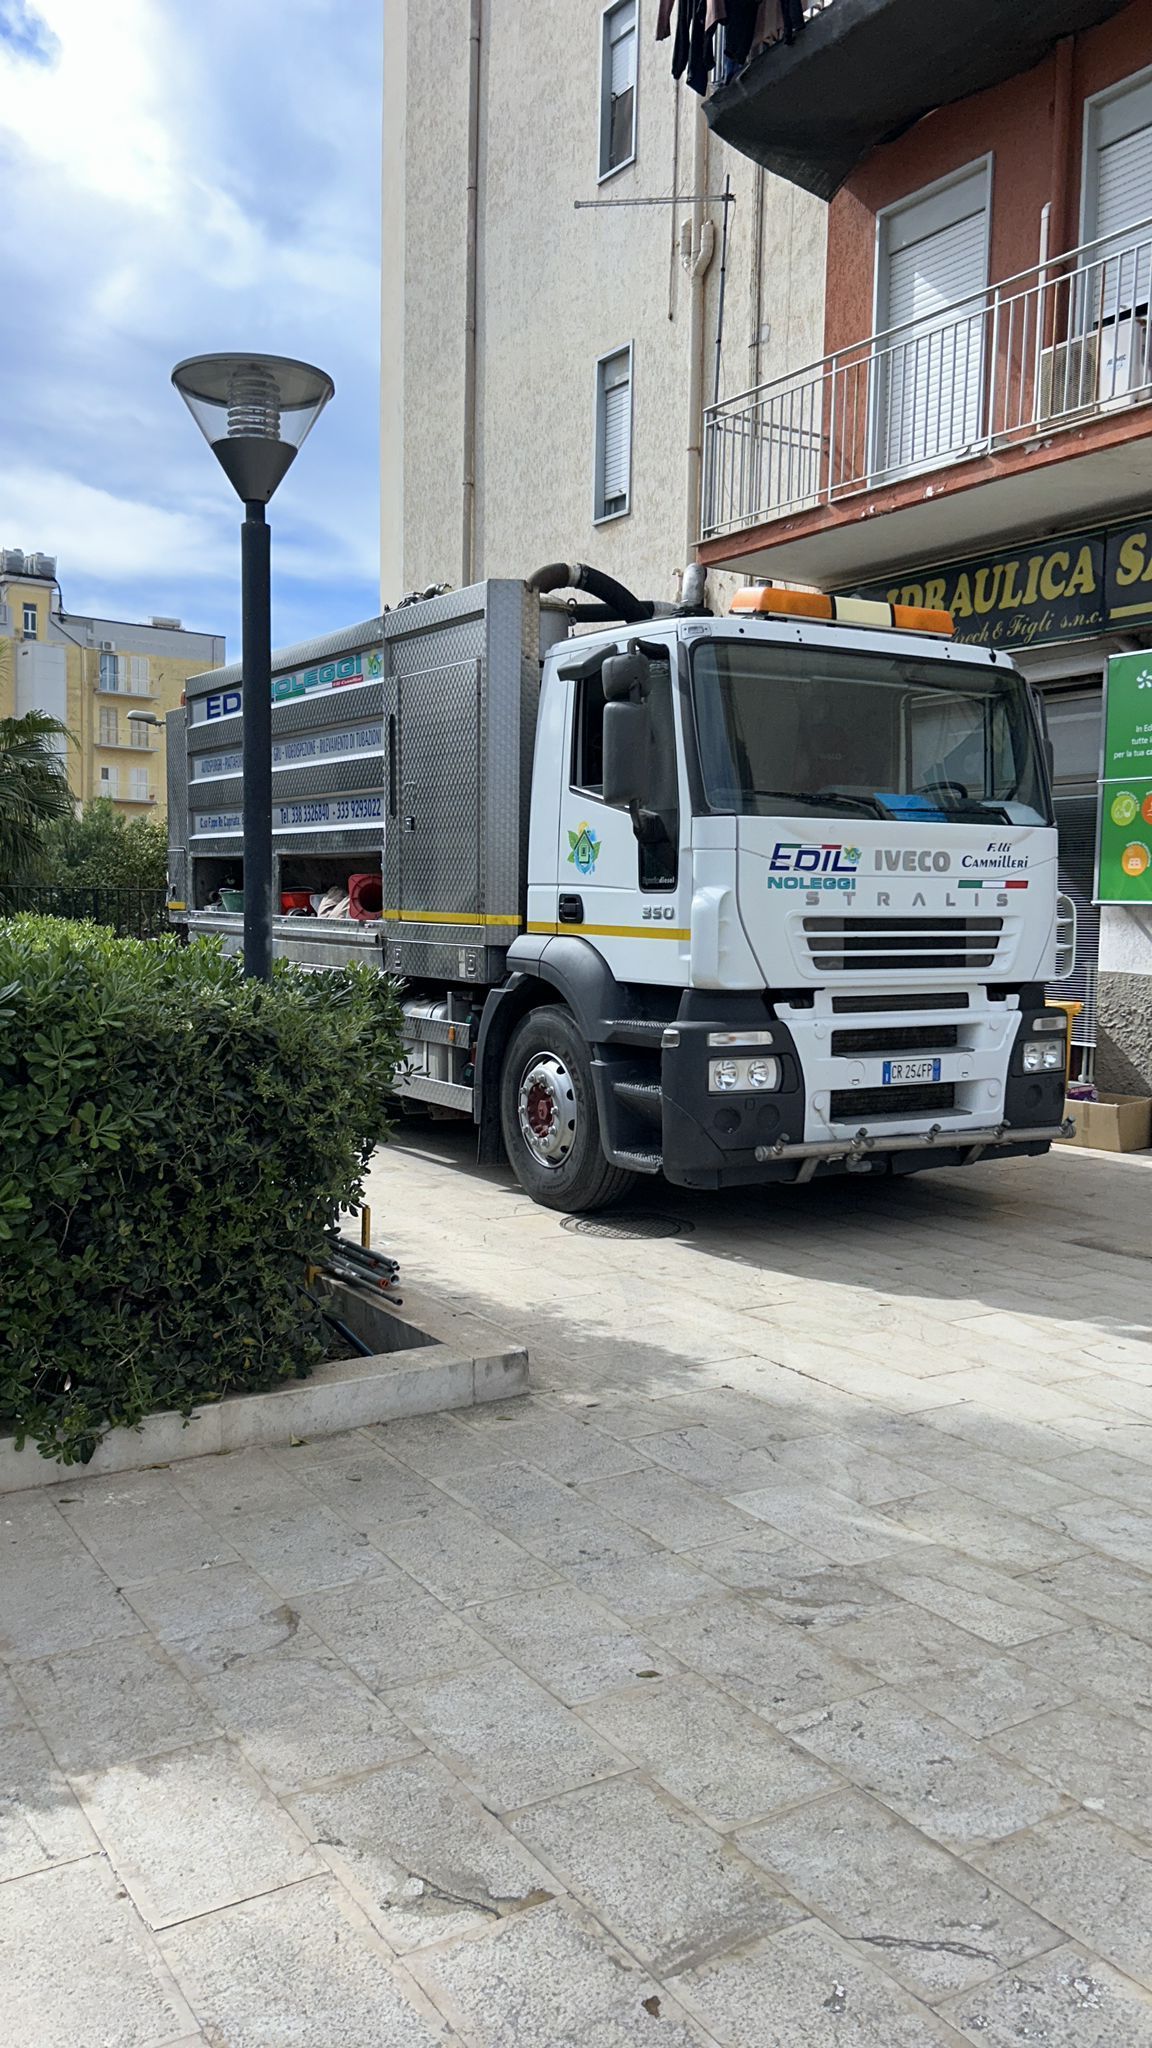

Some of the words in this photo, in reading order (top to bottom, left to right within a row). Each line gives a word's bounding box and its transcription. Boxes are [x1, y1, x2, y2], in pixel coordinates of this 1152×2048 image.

[1116, 532, 1152, 586] S
[992, 620, 1003, 640] &
[1006, 610, 1053, 644] Figli
[1060, 610, 1103, 629] s.n.c.
[206, 692, 242, 720] ED
[271, 655, 362, 697] OLEGGI
[349, 732, 356, 749] DI
[356, 726, 382, 747] TUBAZIONI
[1113, 752, 1125, 761] per
[280, 807, 291, 825] Tel.
[291, 806, 303, 824] 338
[336, 801, 350, 820] 333
[350, 798, 381, 819] 9293022
[768, 843, 858, 873] EDIL
[986, 842, 1012, 853] F.lli
[874, 849, 951, 873] IVECO
[767, 876, 856, 890] NOLEGGI
[804, 891, 1009, 908] STRALIS
[641, 905, 676, 921] 350
[891, 1064, 903, 1079] CR
[905, 1063, 933, 1079] 254FP
